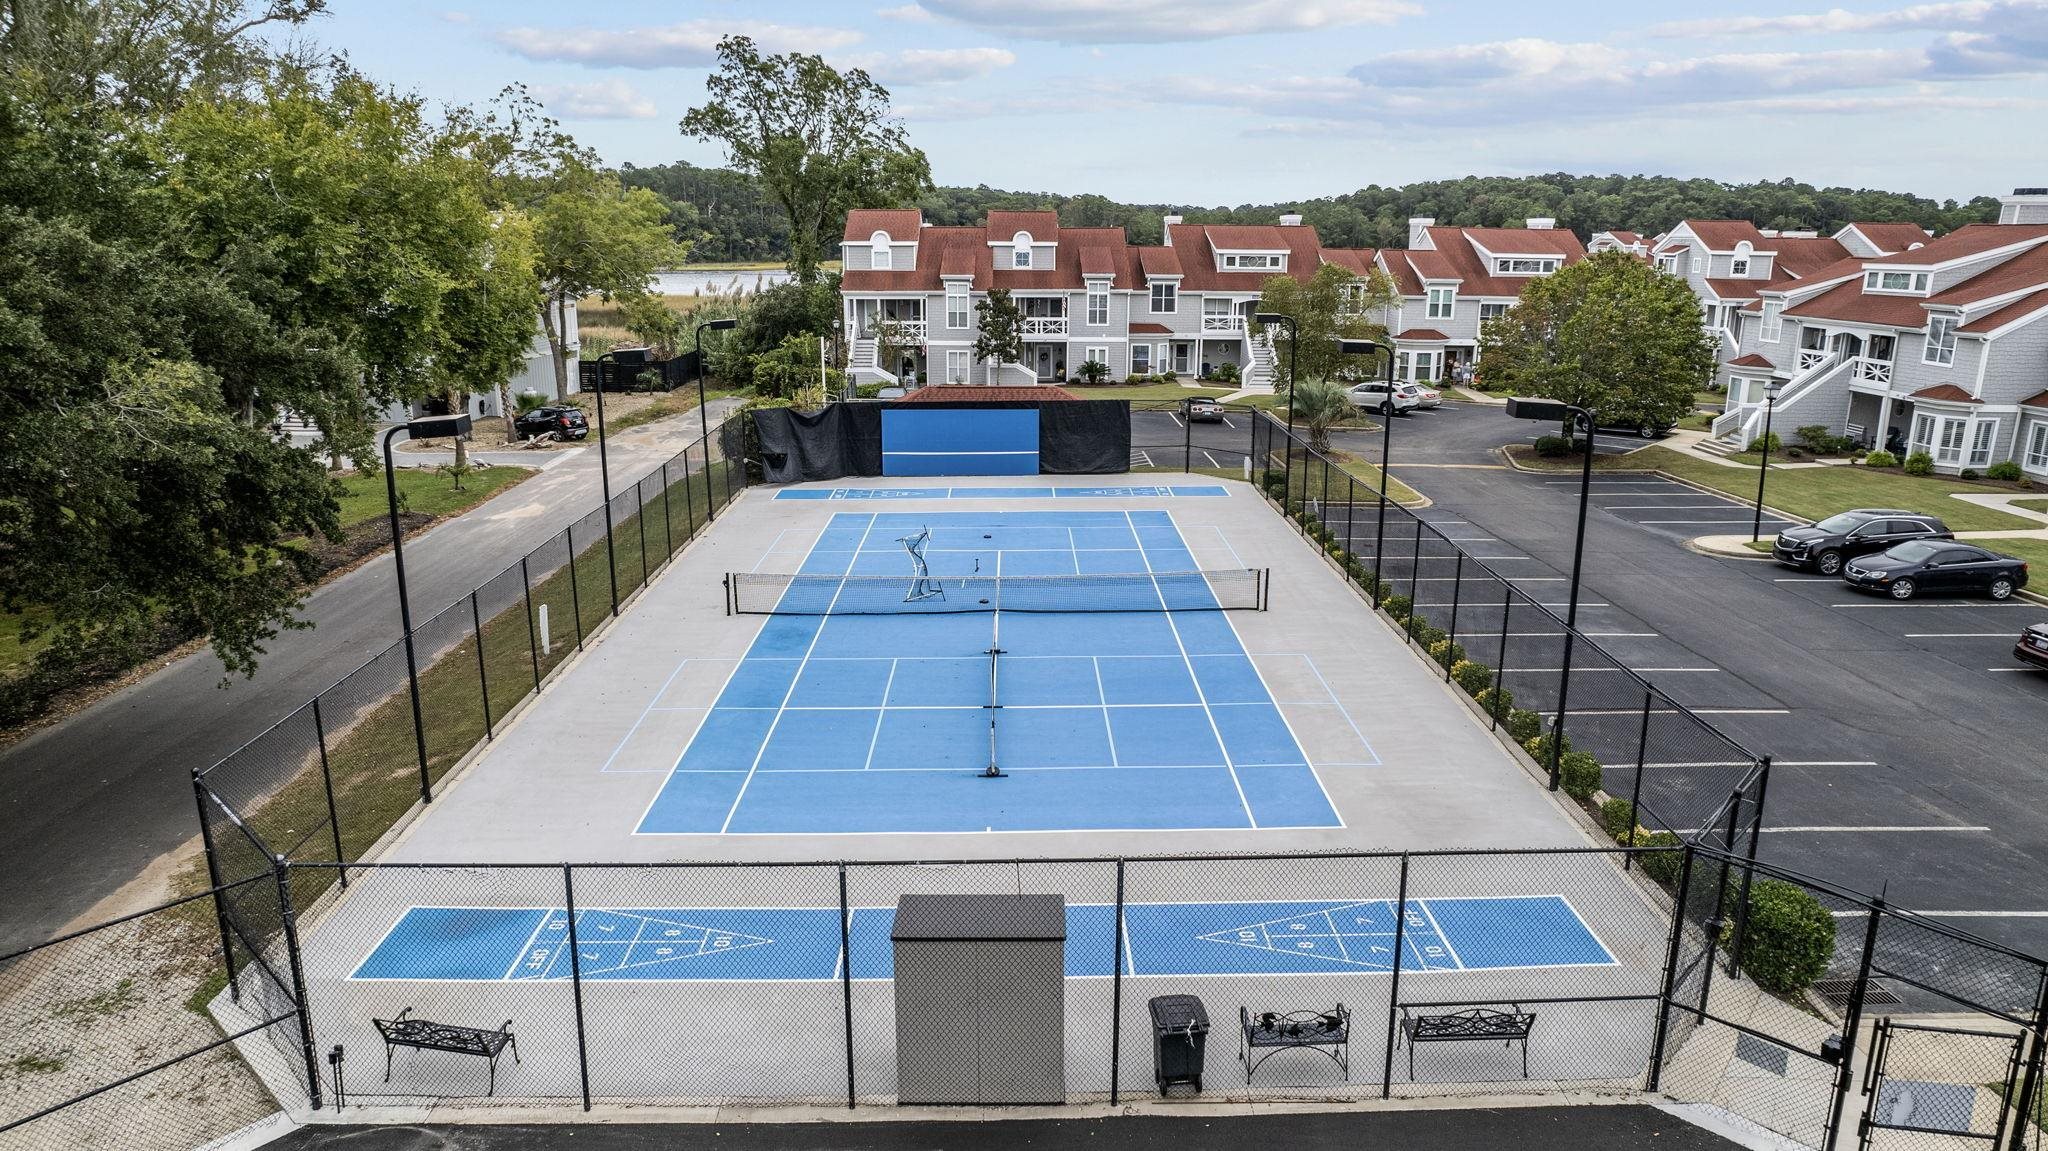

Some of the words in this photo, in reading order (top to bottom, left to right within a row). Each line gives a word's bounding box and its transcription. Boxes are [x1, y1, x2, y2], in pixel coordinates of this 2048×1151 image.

[549, 920, 568, 930] 10
[1239, 931, 1257, 941] 10
[714, 936, 733, 947] 10
[1424, 946, 1447, 957] 10
